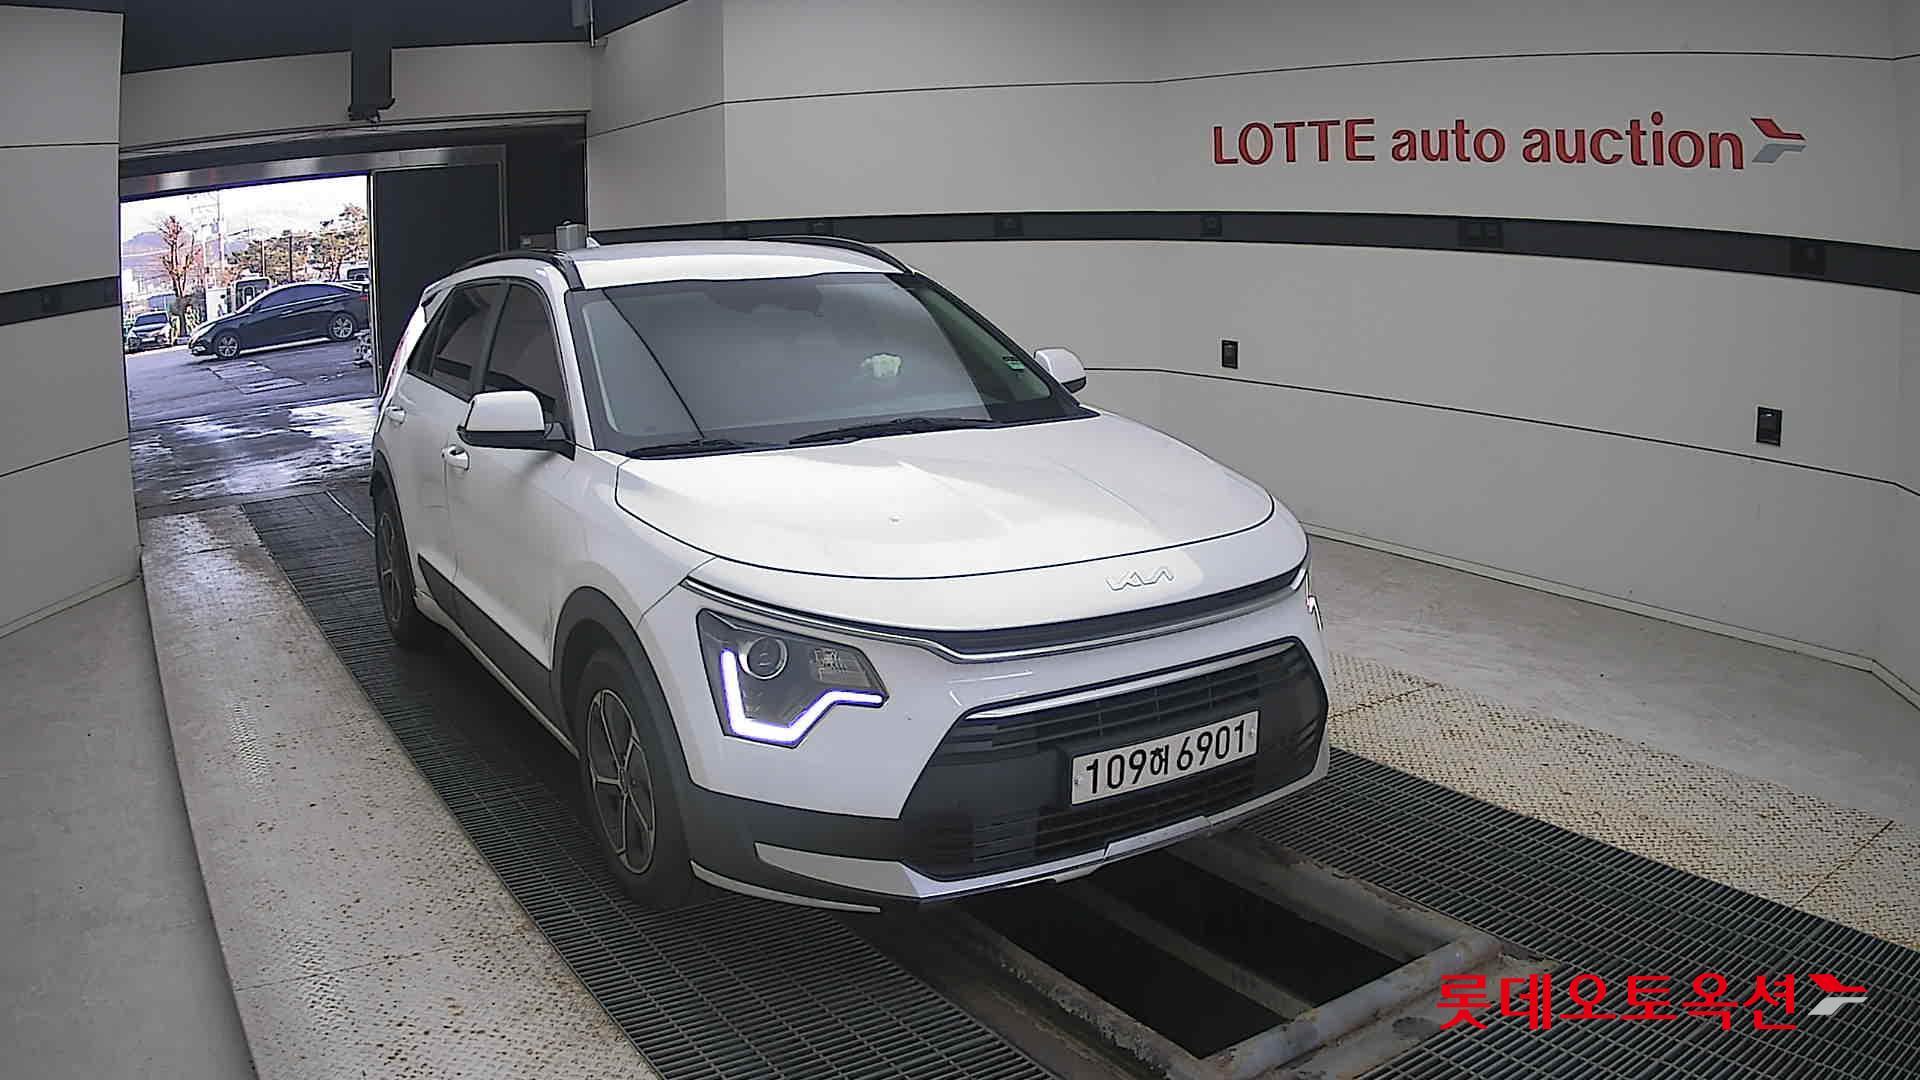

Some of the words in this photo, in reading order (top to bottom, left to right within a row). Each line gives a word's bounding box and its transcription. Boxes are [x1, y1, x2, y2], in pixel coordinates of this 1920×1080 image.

[1213, 118, 1377, 164] LOTTE
[1392, 119, 1505, 162] auto
[1522, 111, 1744, 169] auction
[1176, 719, 1246, 772] 6901
